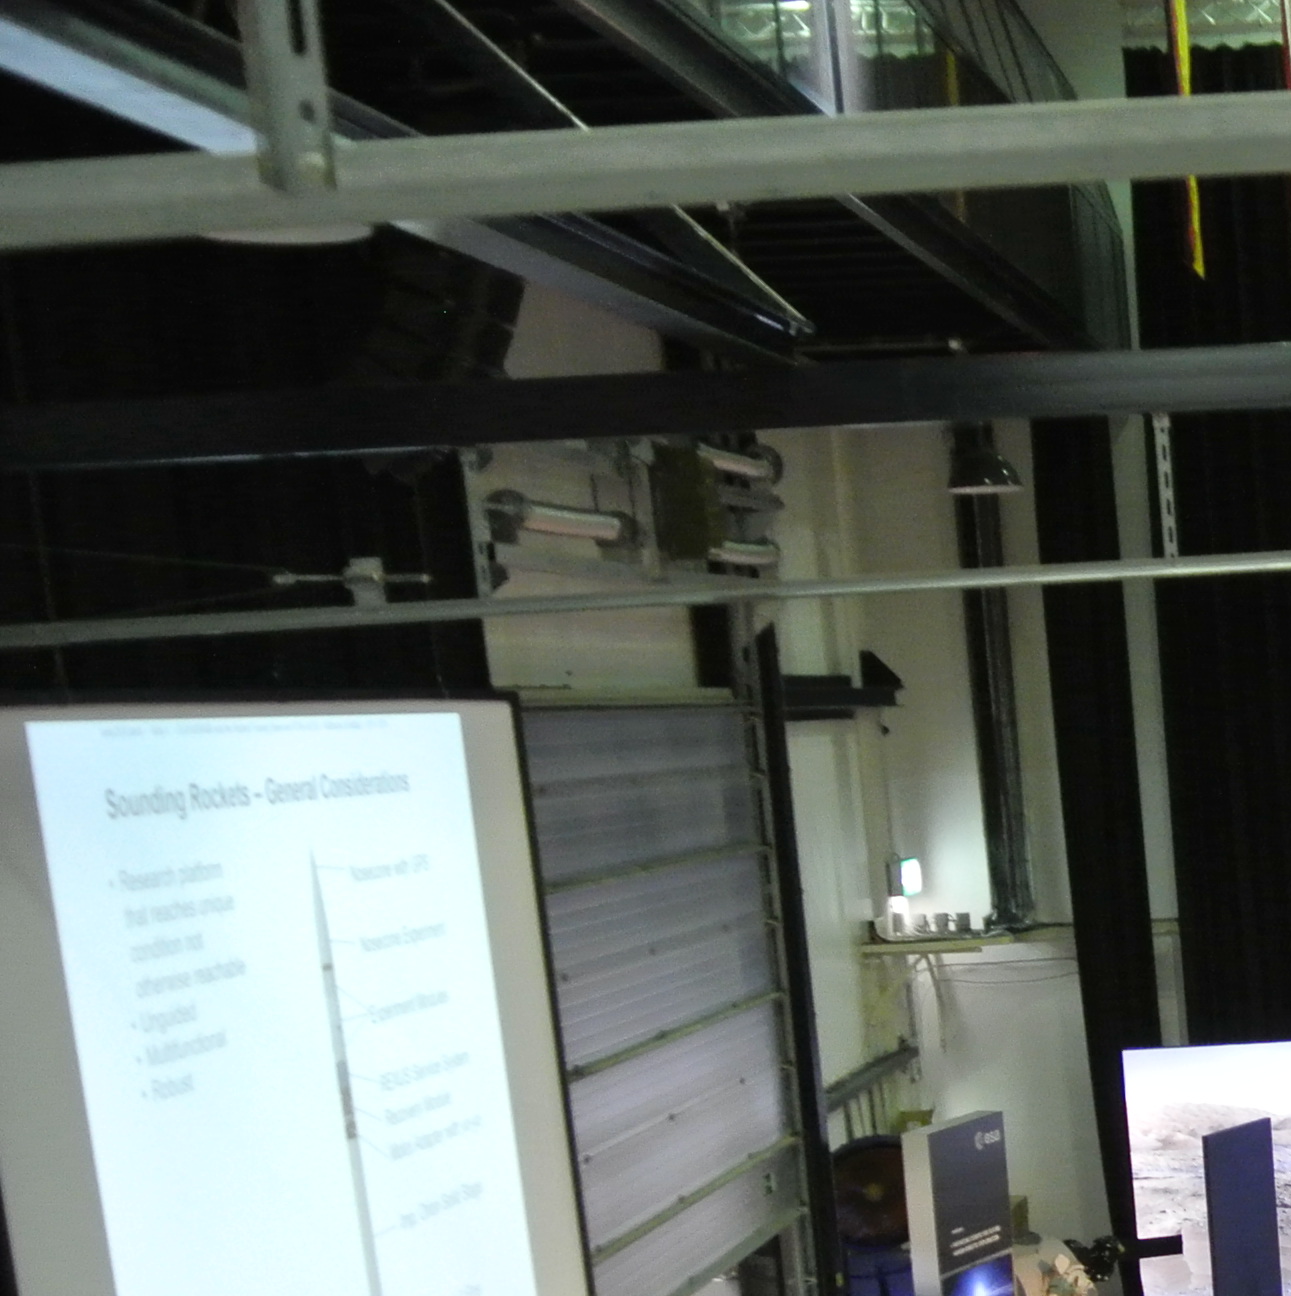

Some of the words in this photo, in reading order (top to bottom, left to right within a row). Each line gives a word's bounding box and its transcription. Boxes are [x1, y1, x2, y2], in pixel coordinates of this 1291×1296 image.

[104, 785, 187, 820] Sounding
[189, 780, 251, 810] Rockets
[264, 776, 318, 806] General
[319, 770, 411, 800] Considerations
[118, 868, 176, 892] Research
[178, 861, 224, 887] platform
